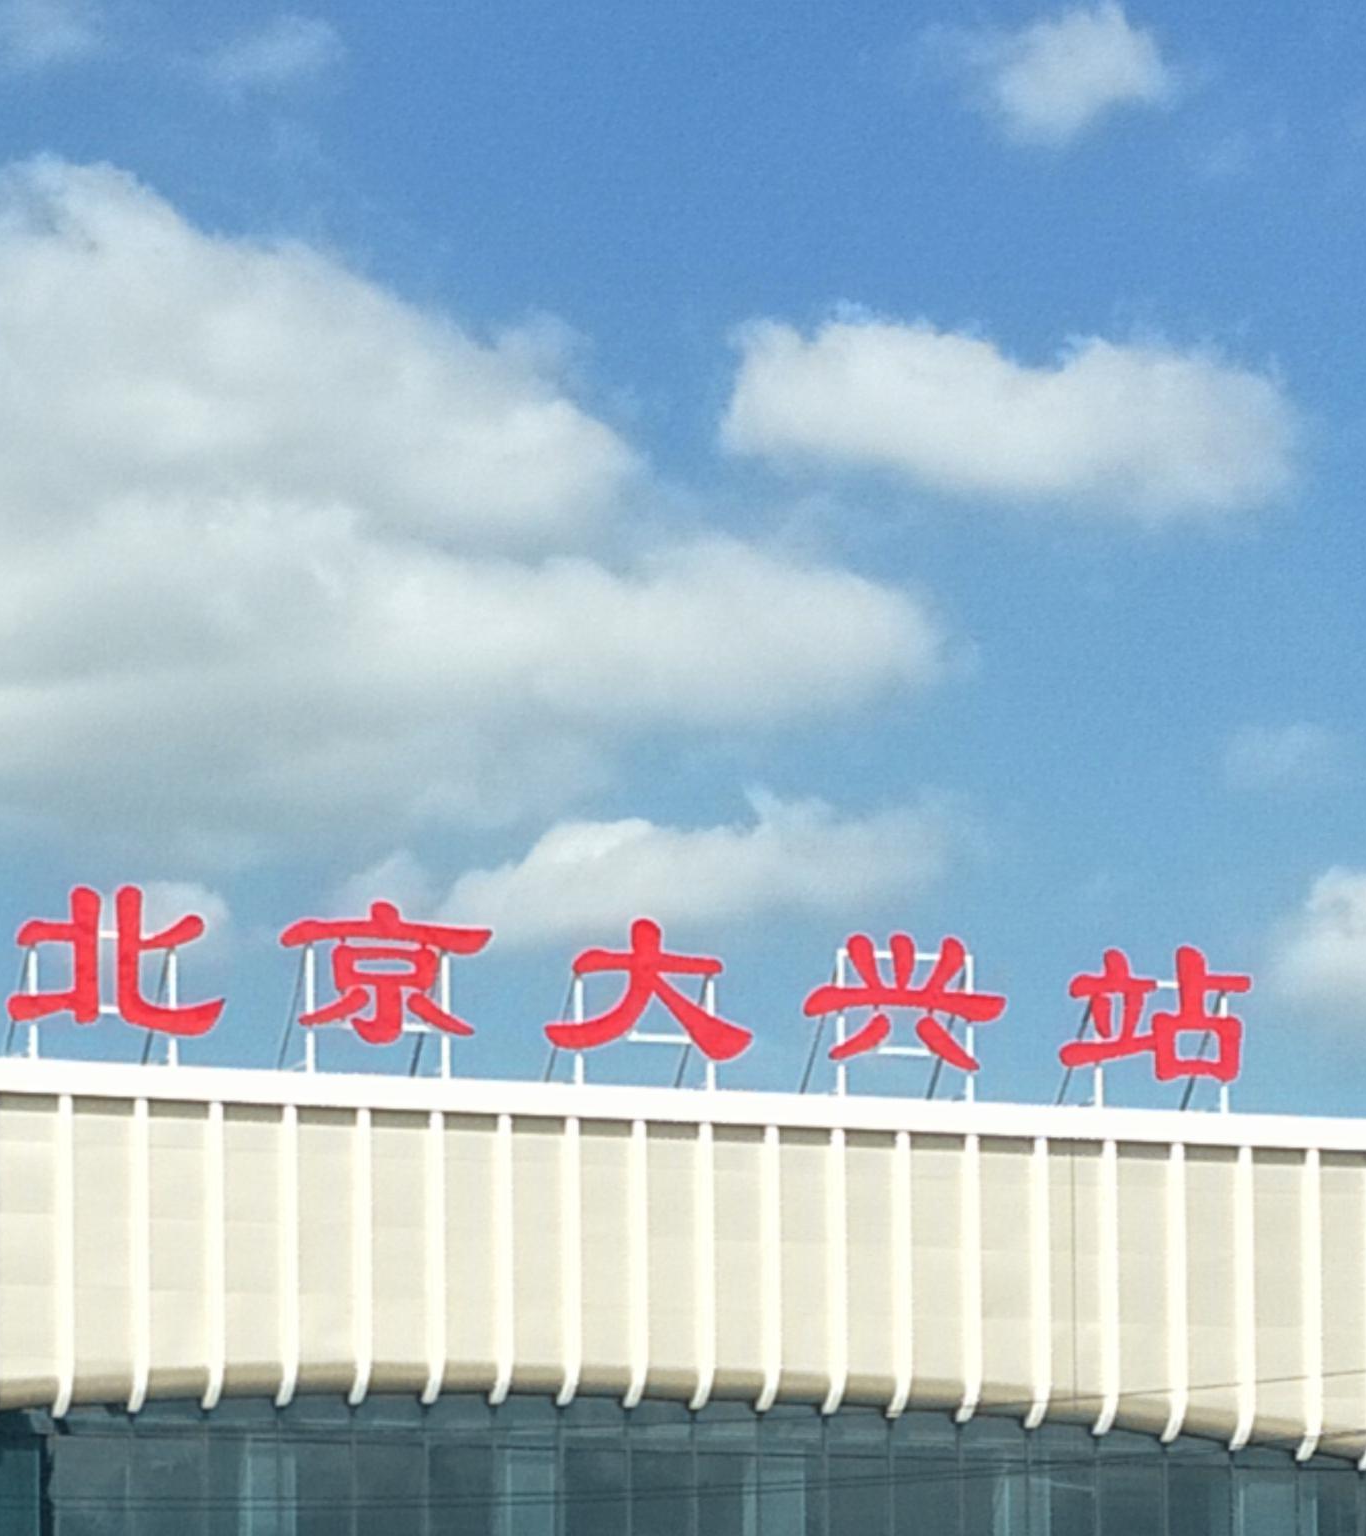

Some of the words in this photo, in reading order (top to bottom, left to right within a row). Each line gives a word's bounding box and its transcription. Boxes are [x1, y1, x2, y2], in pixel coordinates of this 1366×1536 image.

[6, 885, 1251, 1082] 北京大兴站
